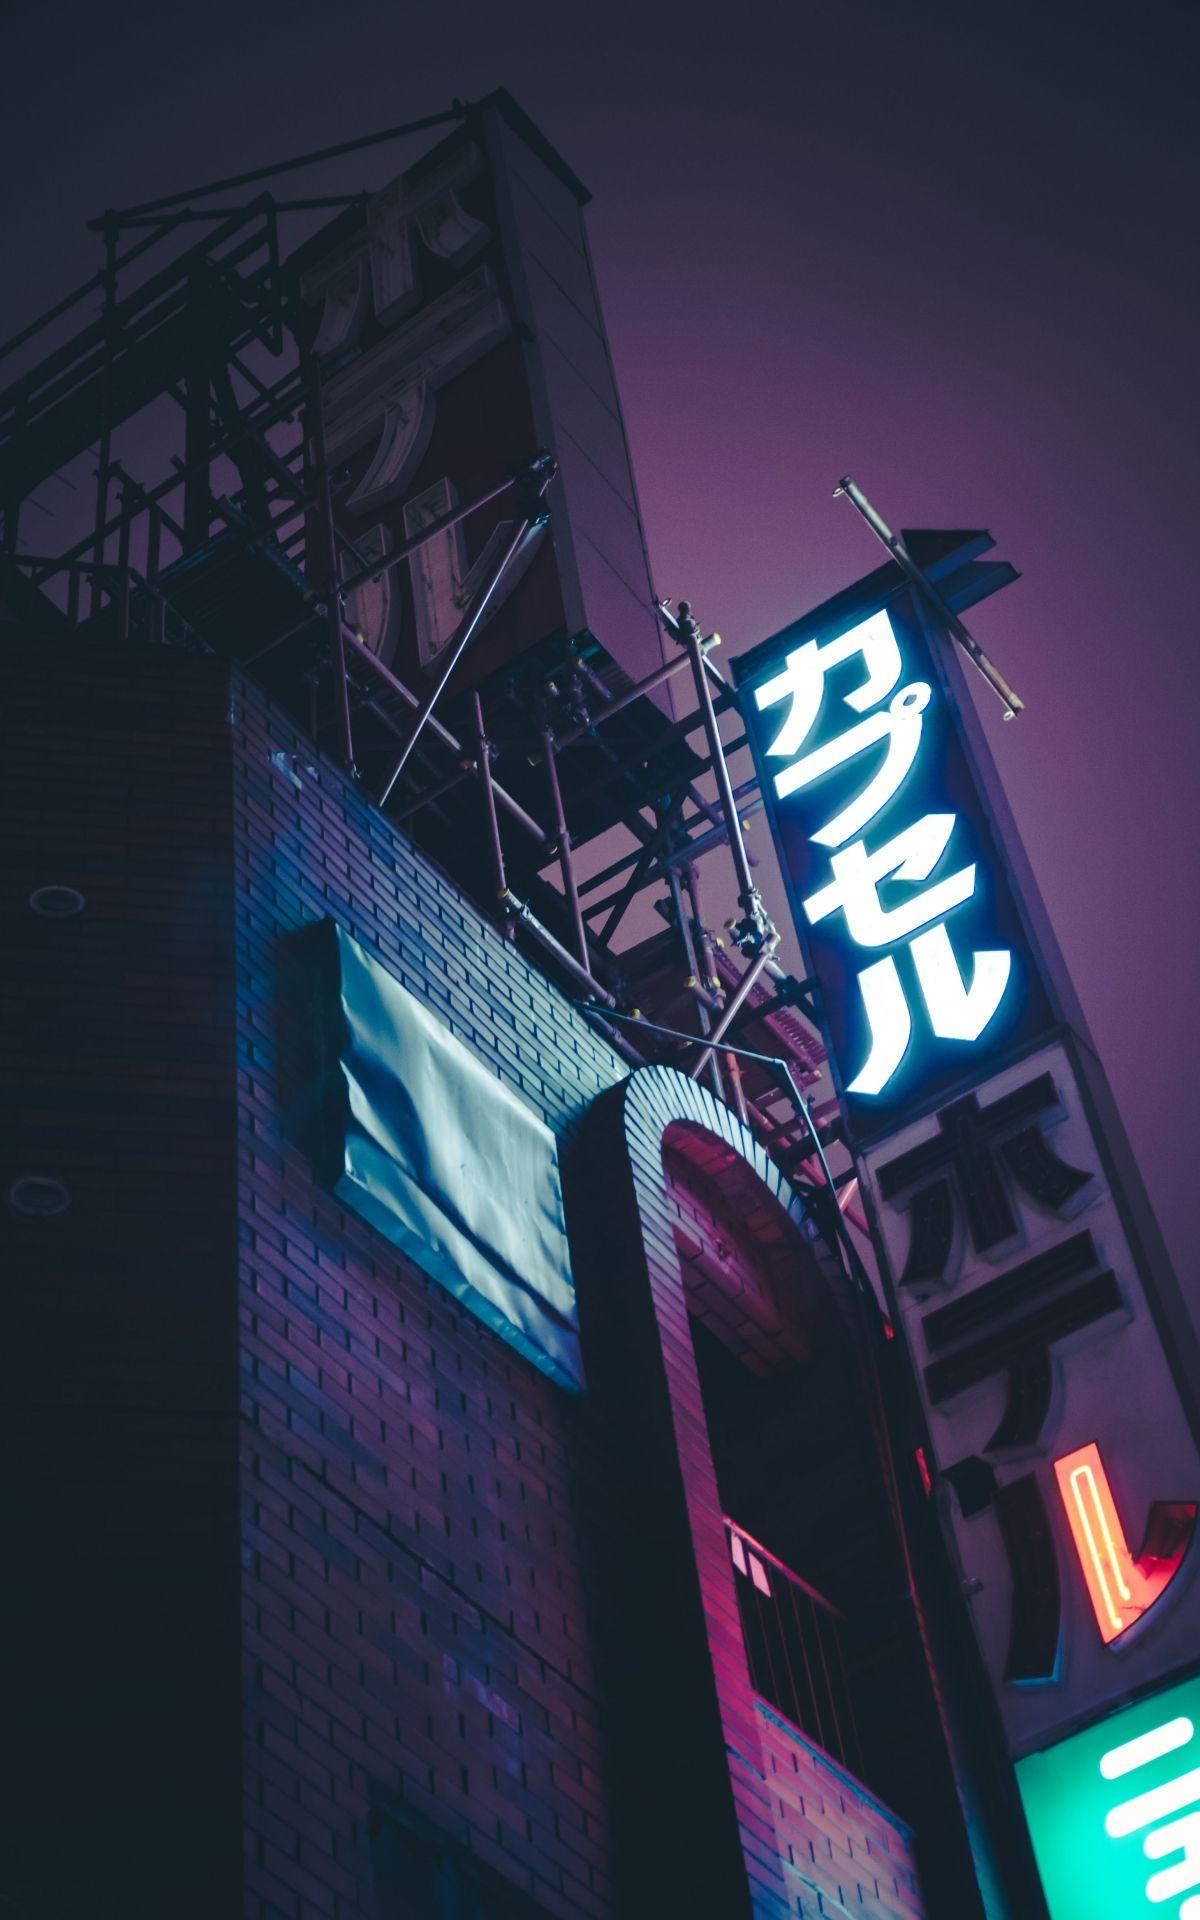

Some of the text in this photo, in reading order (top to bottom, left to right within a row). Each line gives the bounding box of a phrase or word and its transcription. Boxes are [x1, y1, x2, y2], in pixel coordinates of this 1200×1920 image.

[300, 140, 550, 674] ホテル
[754, 607, 1012, 1096] カプセル
[876, 1071, 1200, 1684] ホテル
